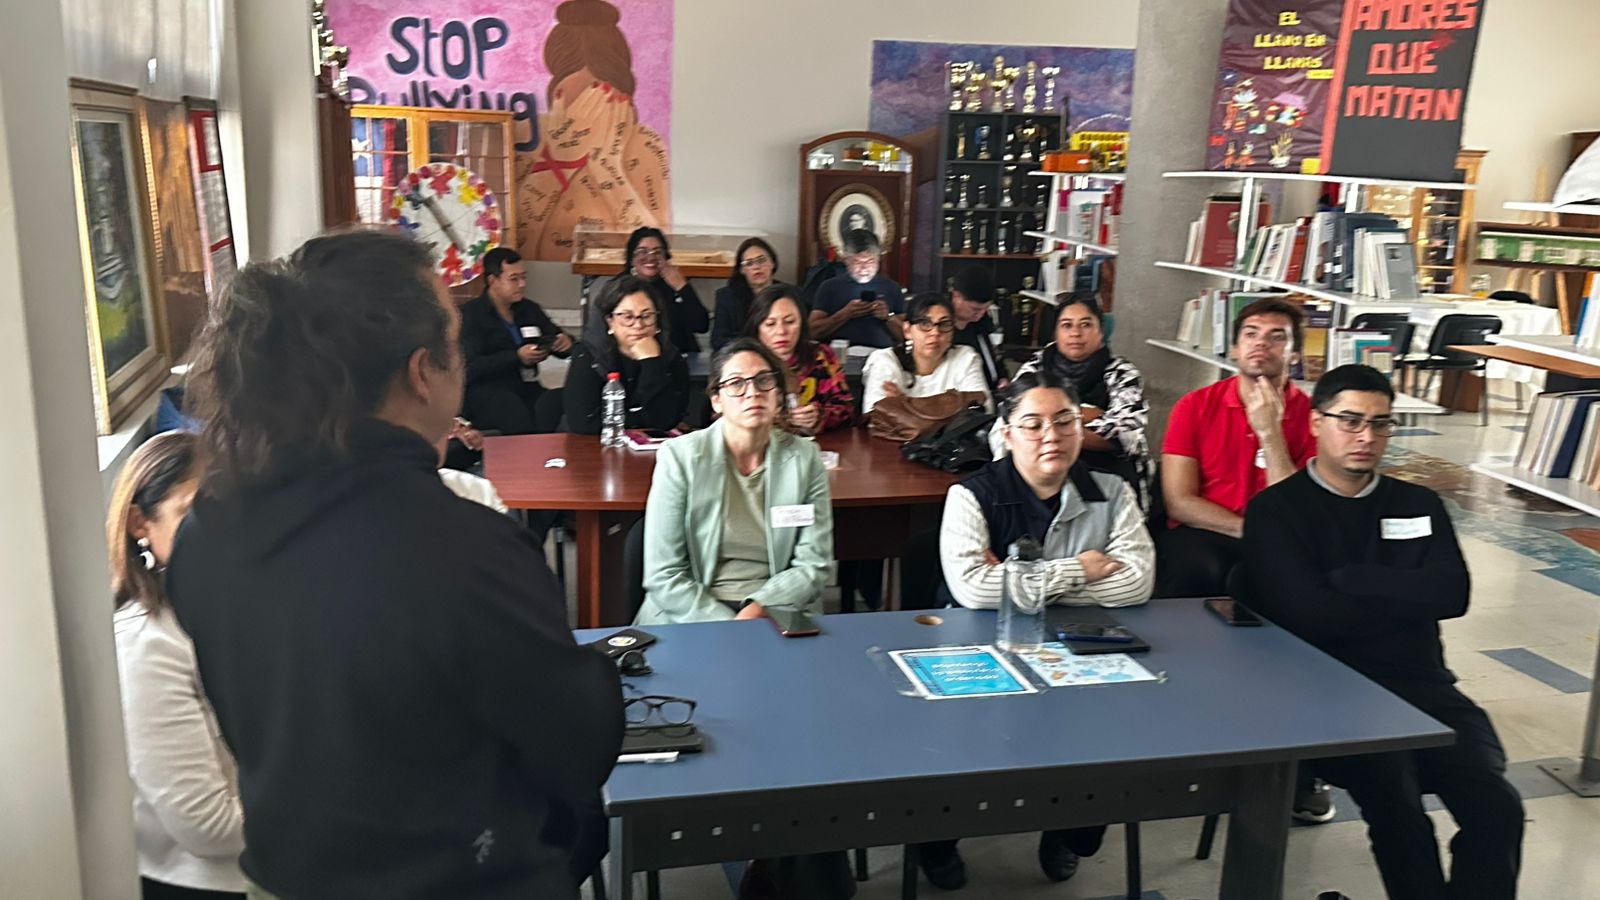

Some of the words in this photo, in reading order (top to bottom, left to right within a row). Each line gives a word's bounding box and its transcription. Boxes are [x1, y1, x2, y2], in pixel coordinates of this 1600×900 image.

[1279, 11, 1302, 26] EL
[1366, 40, 1439, 75] QUE
[1344, 85, 1463, 121] MATAN
